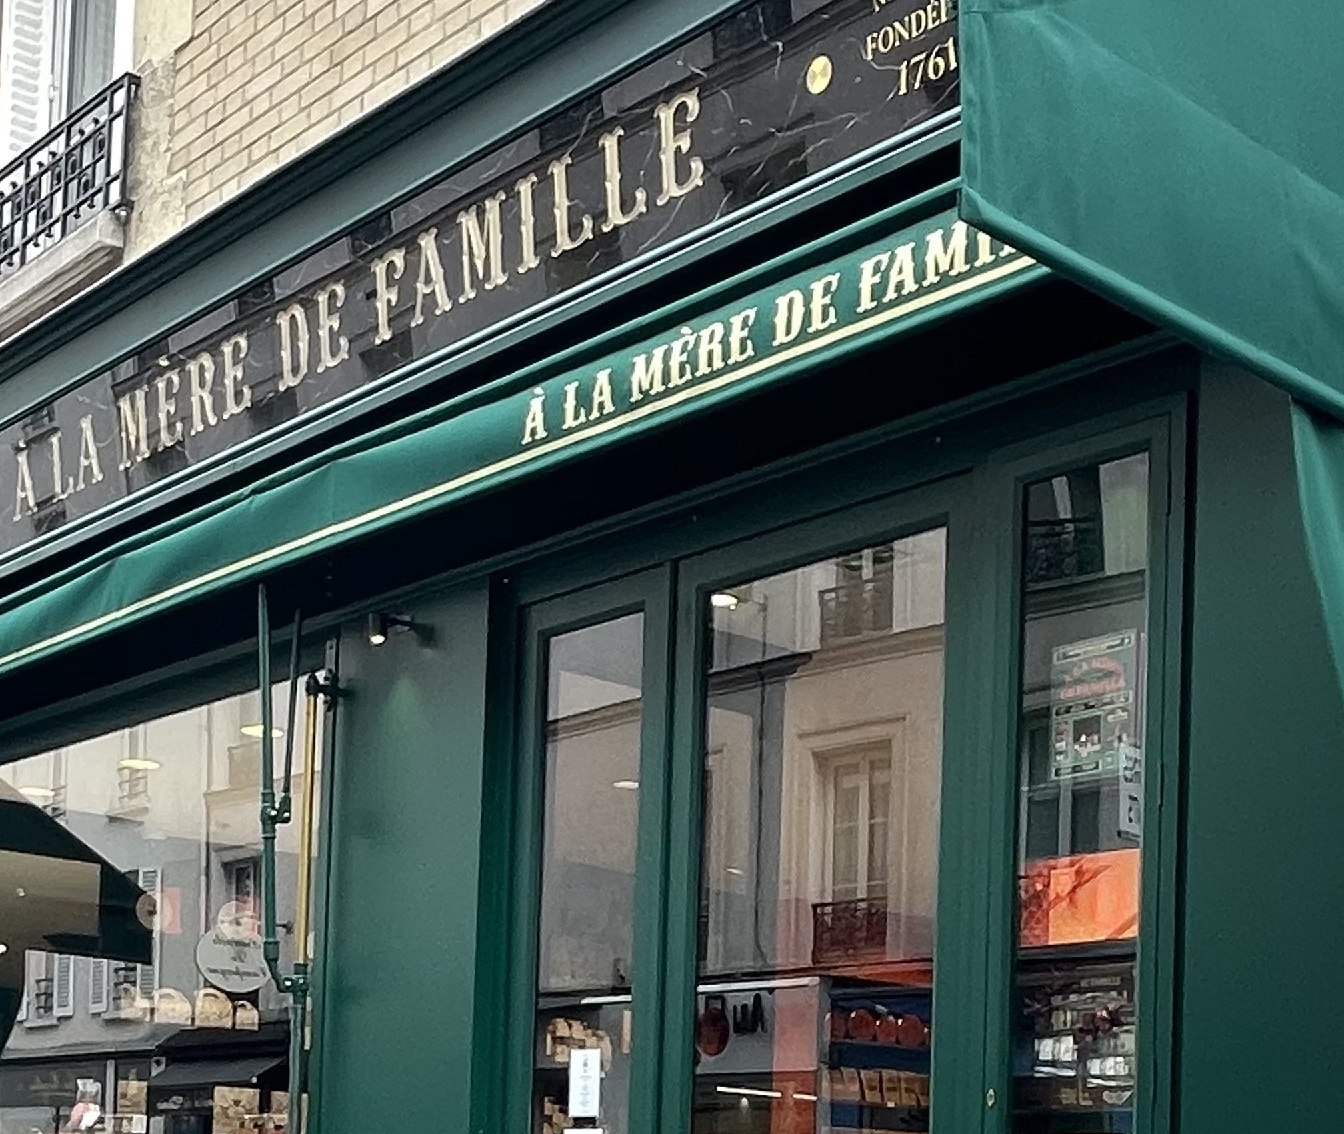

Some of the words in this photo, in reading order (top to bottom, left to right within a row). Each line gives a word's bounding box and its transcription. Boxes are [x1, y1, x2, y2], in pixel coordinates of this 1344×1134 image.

[897, 36, 958, 96] 1761
[12, 438, 38, 522] À
[50, 413, 104, 504] LA
[116, 331, 253, 472] MÈRE
[275, 280, 350, 391] DE
[370, 87, 705, 346] FAMILLE
[520, 387, 548, 445] À
[560, 367, 616, 430] LA
[628, 307, 758, 402] MÈRE
[771, 272, 842, 347] DE
[855, 219, 1016, 313] FAMI
